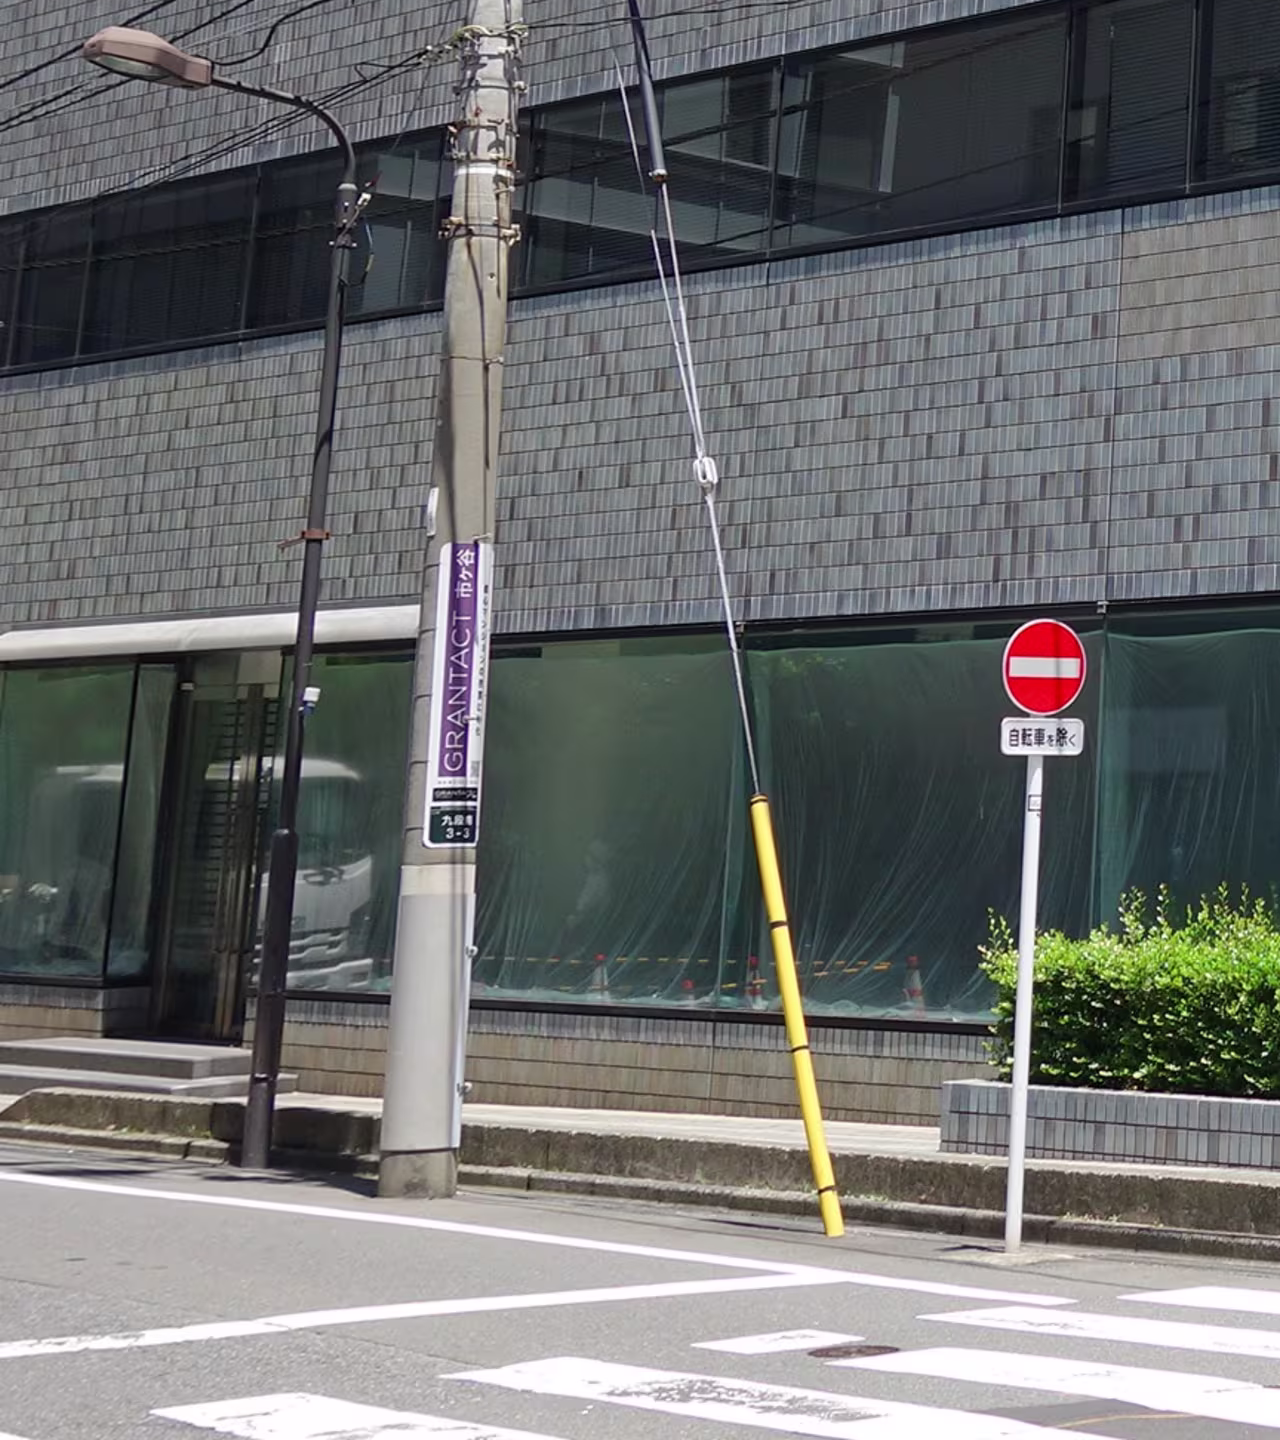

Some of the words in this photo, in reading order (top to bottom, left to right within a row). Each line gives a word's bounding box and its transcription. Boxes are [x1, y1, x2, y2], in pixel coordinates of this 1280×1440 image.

[444, 610, 472, 771] GRANTACT
[1009, 727, 1077, 747] 自転車を除く
[445, 827, 470, 839] 3-3
